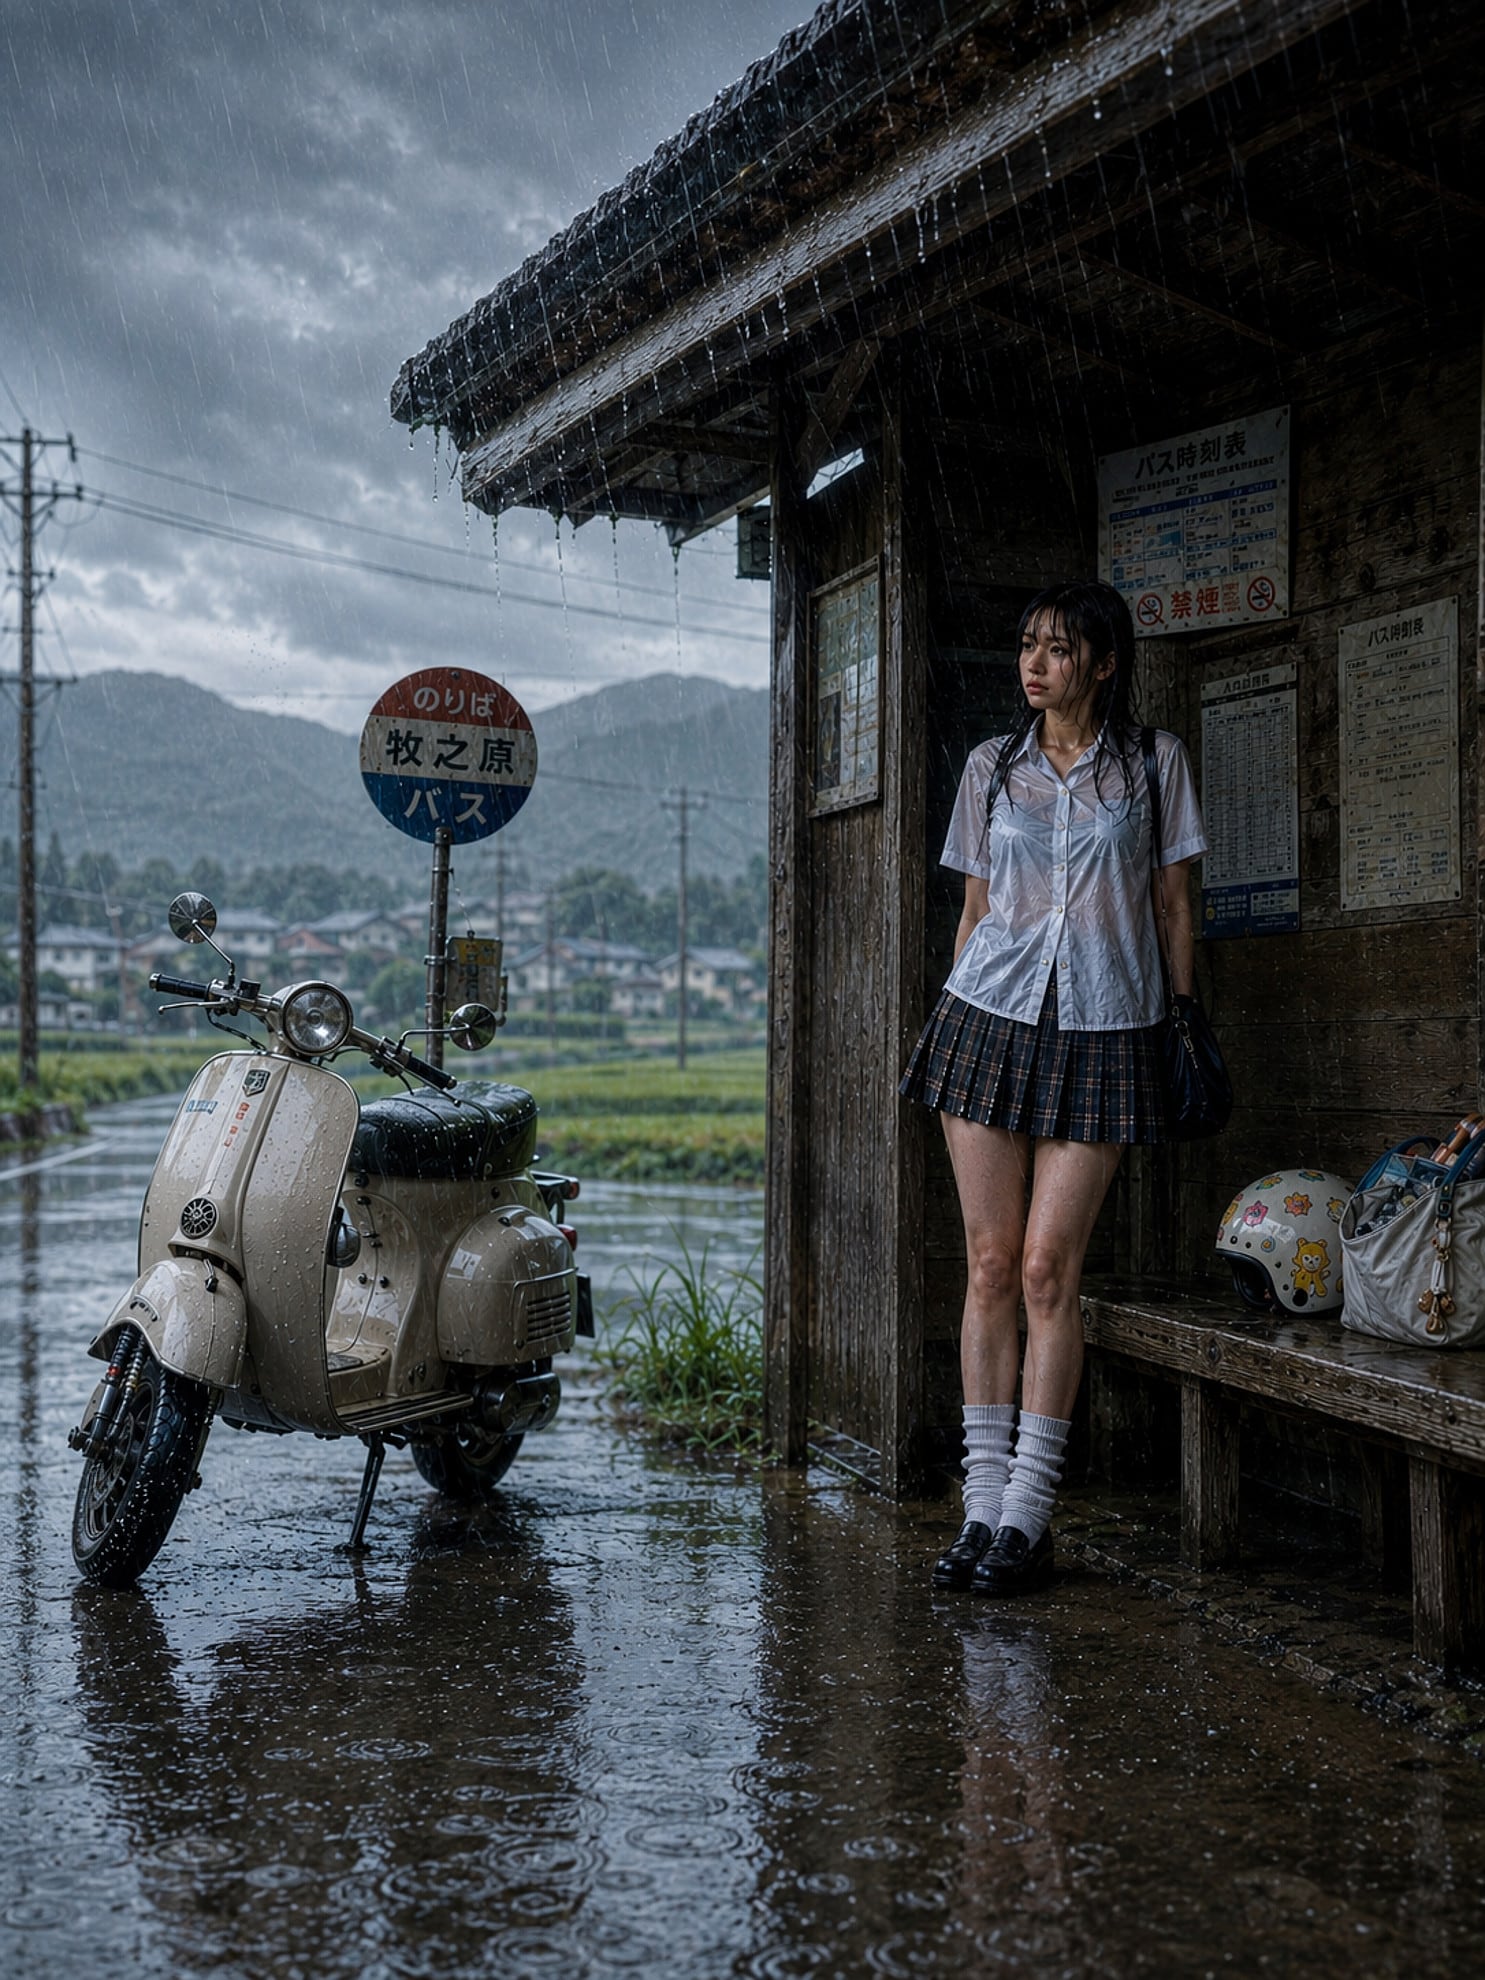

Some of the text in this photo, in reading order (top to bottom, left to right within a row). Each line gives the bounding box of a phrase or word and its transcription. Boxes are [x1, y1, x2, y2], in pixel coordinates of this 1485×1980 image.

[1170, 586, 1221, 620] 禁煙
[413, 686, 497, 718] のりば
[385, 728, 516, 775] 牧之原
[403, 786, 487, 826] バス
